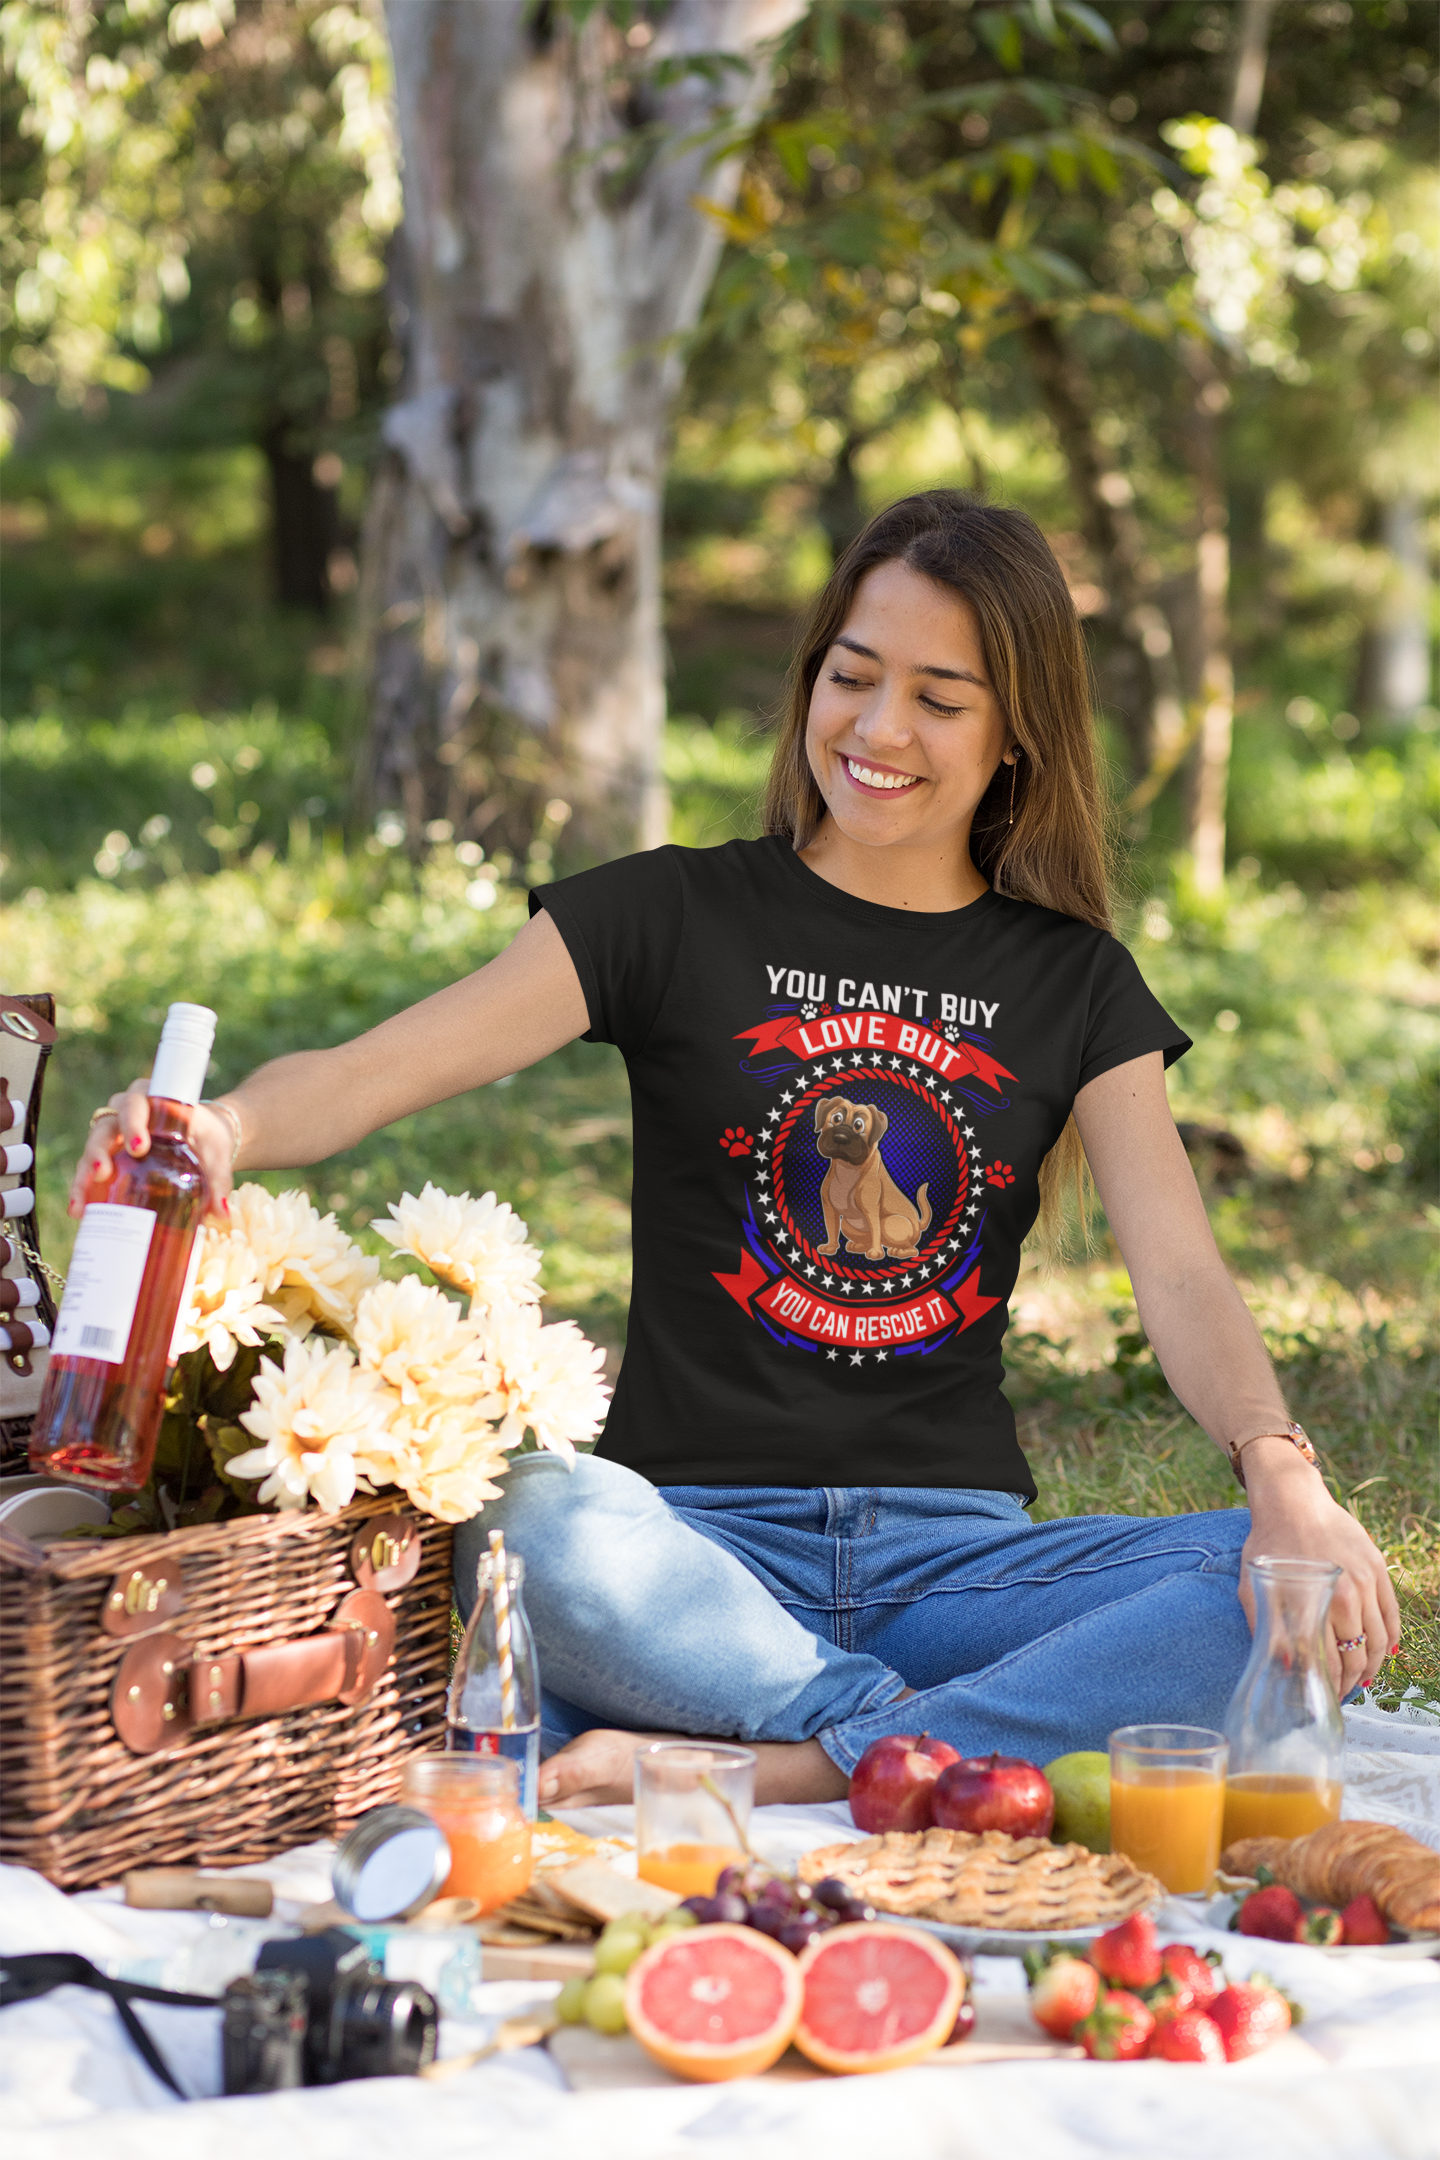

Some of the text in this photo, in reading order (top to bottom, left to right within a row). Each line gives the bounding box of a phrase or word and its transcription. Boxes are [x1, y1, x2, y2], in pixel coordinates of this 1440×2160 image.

[765, 964, 1000, 1029] YOU CAN'T BUY
[798, 1015, 961, 1073] LOVE BUT
[769, 1282, 946, 1341] YOU CAN RESCUE IT
